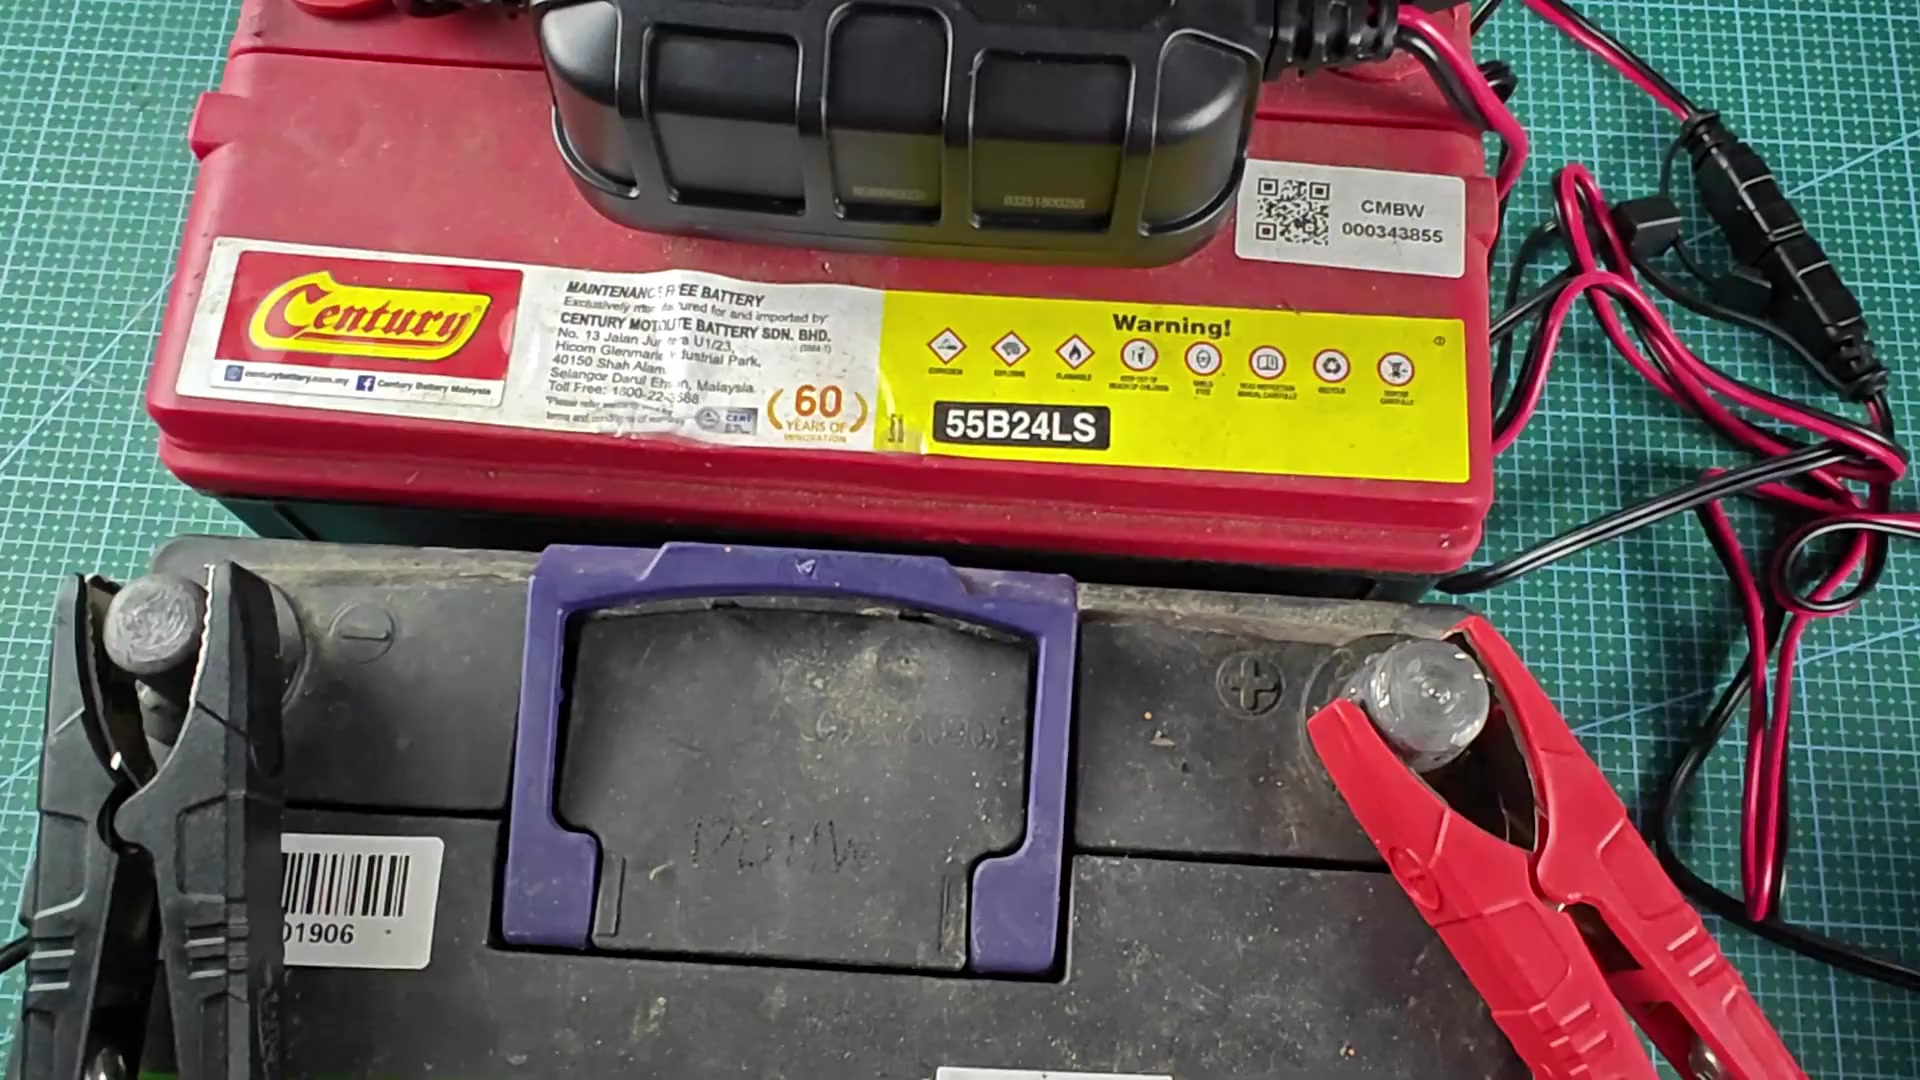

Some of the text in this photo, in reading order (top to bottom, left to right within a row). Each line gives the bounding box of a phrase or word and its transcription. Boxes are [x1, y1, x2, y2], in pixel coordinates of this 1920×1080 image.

[1361, 199, 1425, 218] CMBW
[1341, 221, 1444, 243] 000343855
[701, 285, 766, 308] BATTERY
[263, 283, 473, 342] Century
[563, 296, 631, 314] Exclusively
[711, 304, 726, 317] for
[730, 309, 753, 321] and
[756, 312, 809, 324] imported
[557, 327, 579, 340] No.
[586, 329, 601, 342] 13
[603, 331, 639, 346] Jalan
[560, 311, 628, 331] CENTURY
[696, 319, 759, 340] BATTERY
[762, 327, 795, 342] SDN.
[798, 328, 832, 344] BHD.
[1112, 312, 1232, 341] Warning!
[555, 340, 597, 354] Hicom
[552, 354, 594, 370] 40150
[597, 357, 631, 374] Shah
[550, 366, 609, 383] Selangor
[612, 372, 648, 387] Darul
[377, 379, 492, 396] Century Battery Malaysia
[548, 379, 571, 393] Toll
[573, 381, 609, 396] Free:
[795, 384, 843, 418] 60
[785, 419, 846, 434] YEARS OF
[944, 408, 1097, 443] 55B24LS
